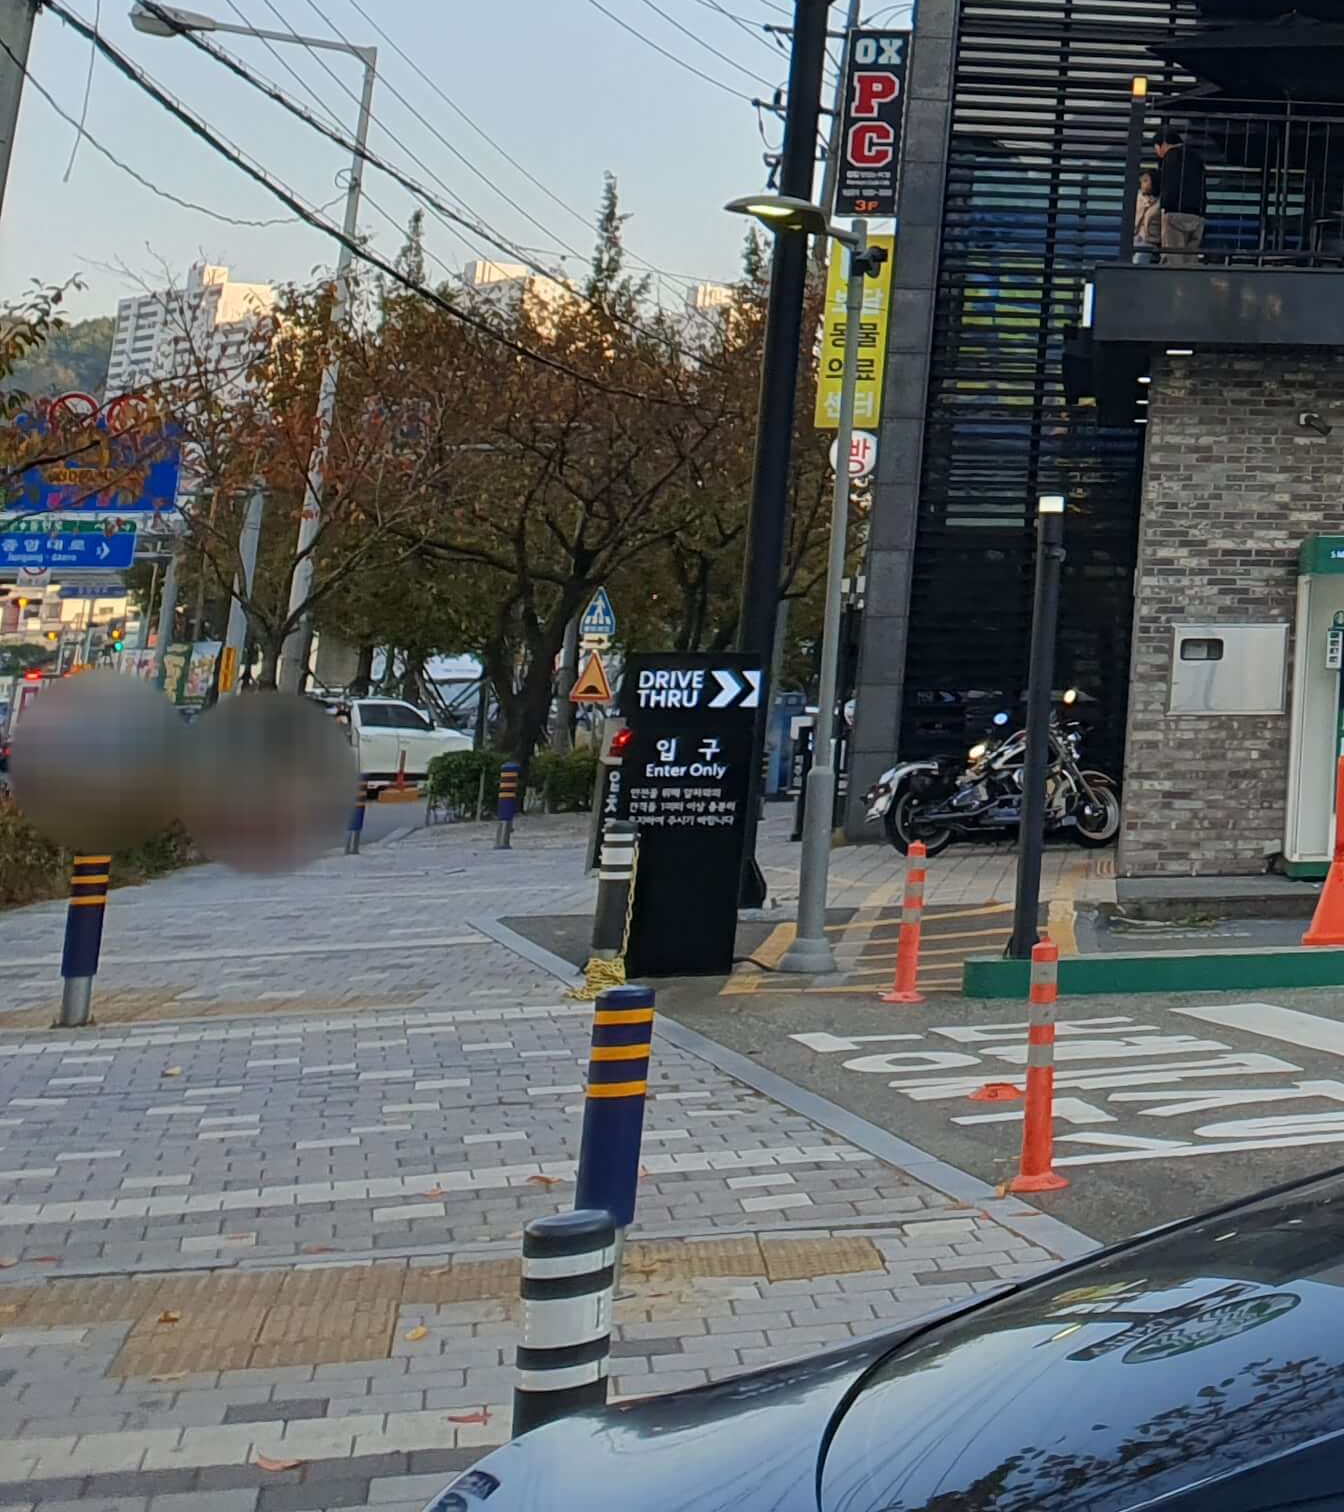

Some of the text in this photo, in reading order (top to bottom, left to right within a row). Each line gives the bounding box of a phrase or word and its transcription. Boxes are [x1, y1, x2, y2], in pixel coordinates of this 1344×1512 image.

[855, 38, 902, 64] OX
[846, 71, 899, 167] PC
[829, 322, 880, 349] 동물
[825, 357, 876, 382] 의료
[639, 670, 705, 689] DRIVE
[636, 689, 699, 708] THRU
[645, 763, 727, 779] Enter Only
